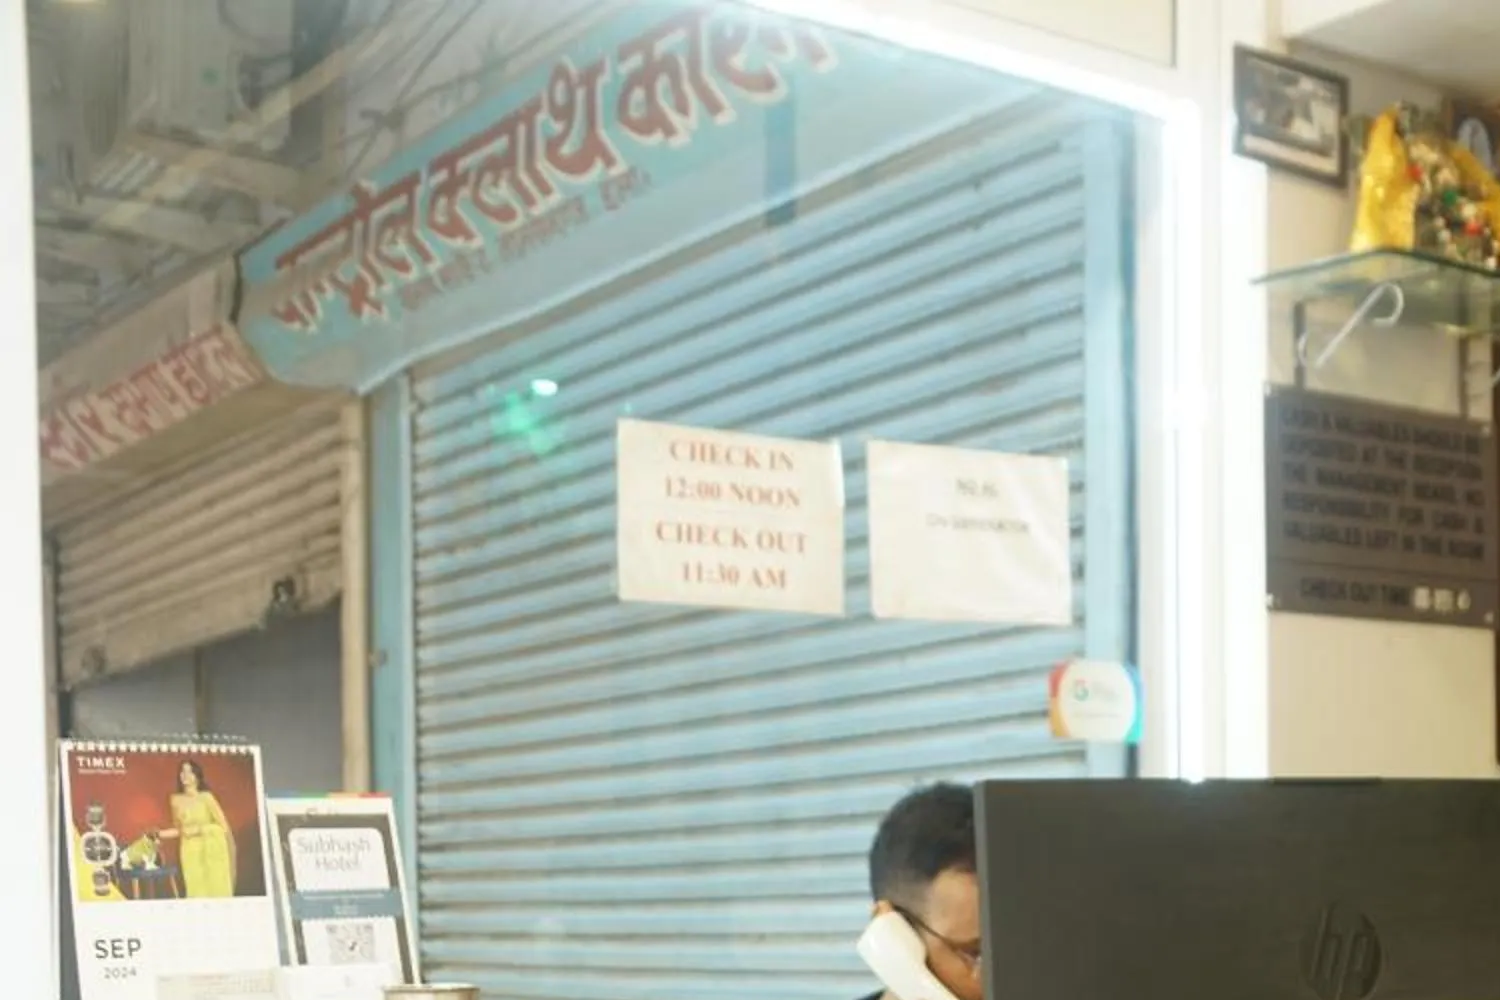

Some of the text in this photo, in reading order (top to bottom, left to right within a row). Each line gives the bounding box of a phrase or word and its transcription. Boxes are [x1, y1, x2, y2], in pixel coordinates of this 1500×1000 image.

[669, 440, 796, 472] CHECK IN
[664, 475, 802, 508] 12:00 NOON
[656, 520, 809, 557] CHECK OUT
[682, 561, 787, 590] 11:30 AM
[76, 756, 126, 770] TIMEX
[297, 833, 372, 857] Subhash
[315, 853, 362, 873] Hotel
[94, 938, 142, 959] SEP
[103, 965, 138, 980] 2024
